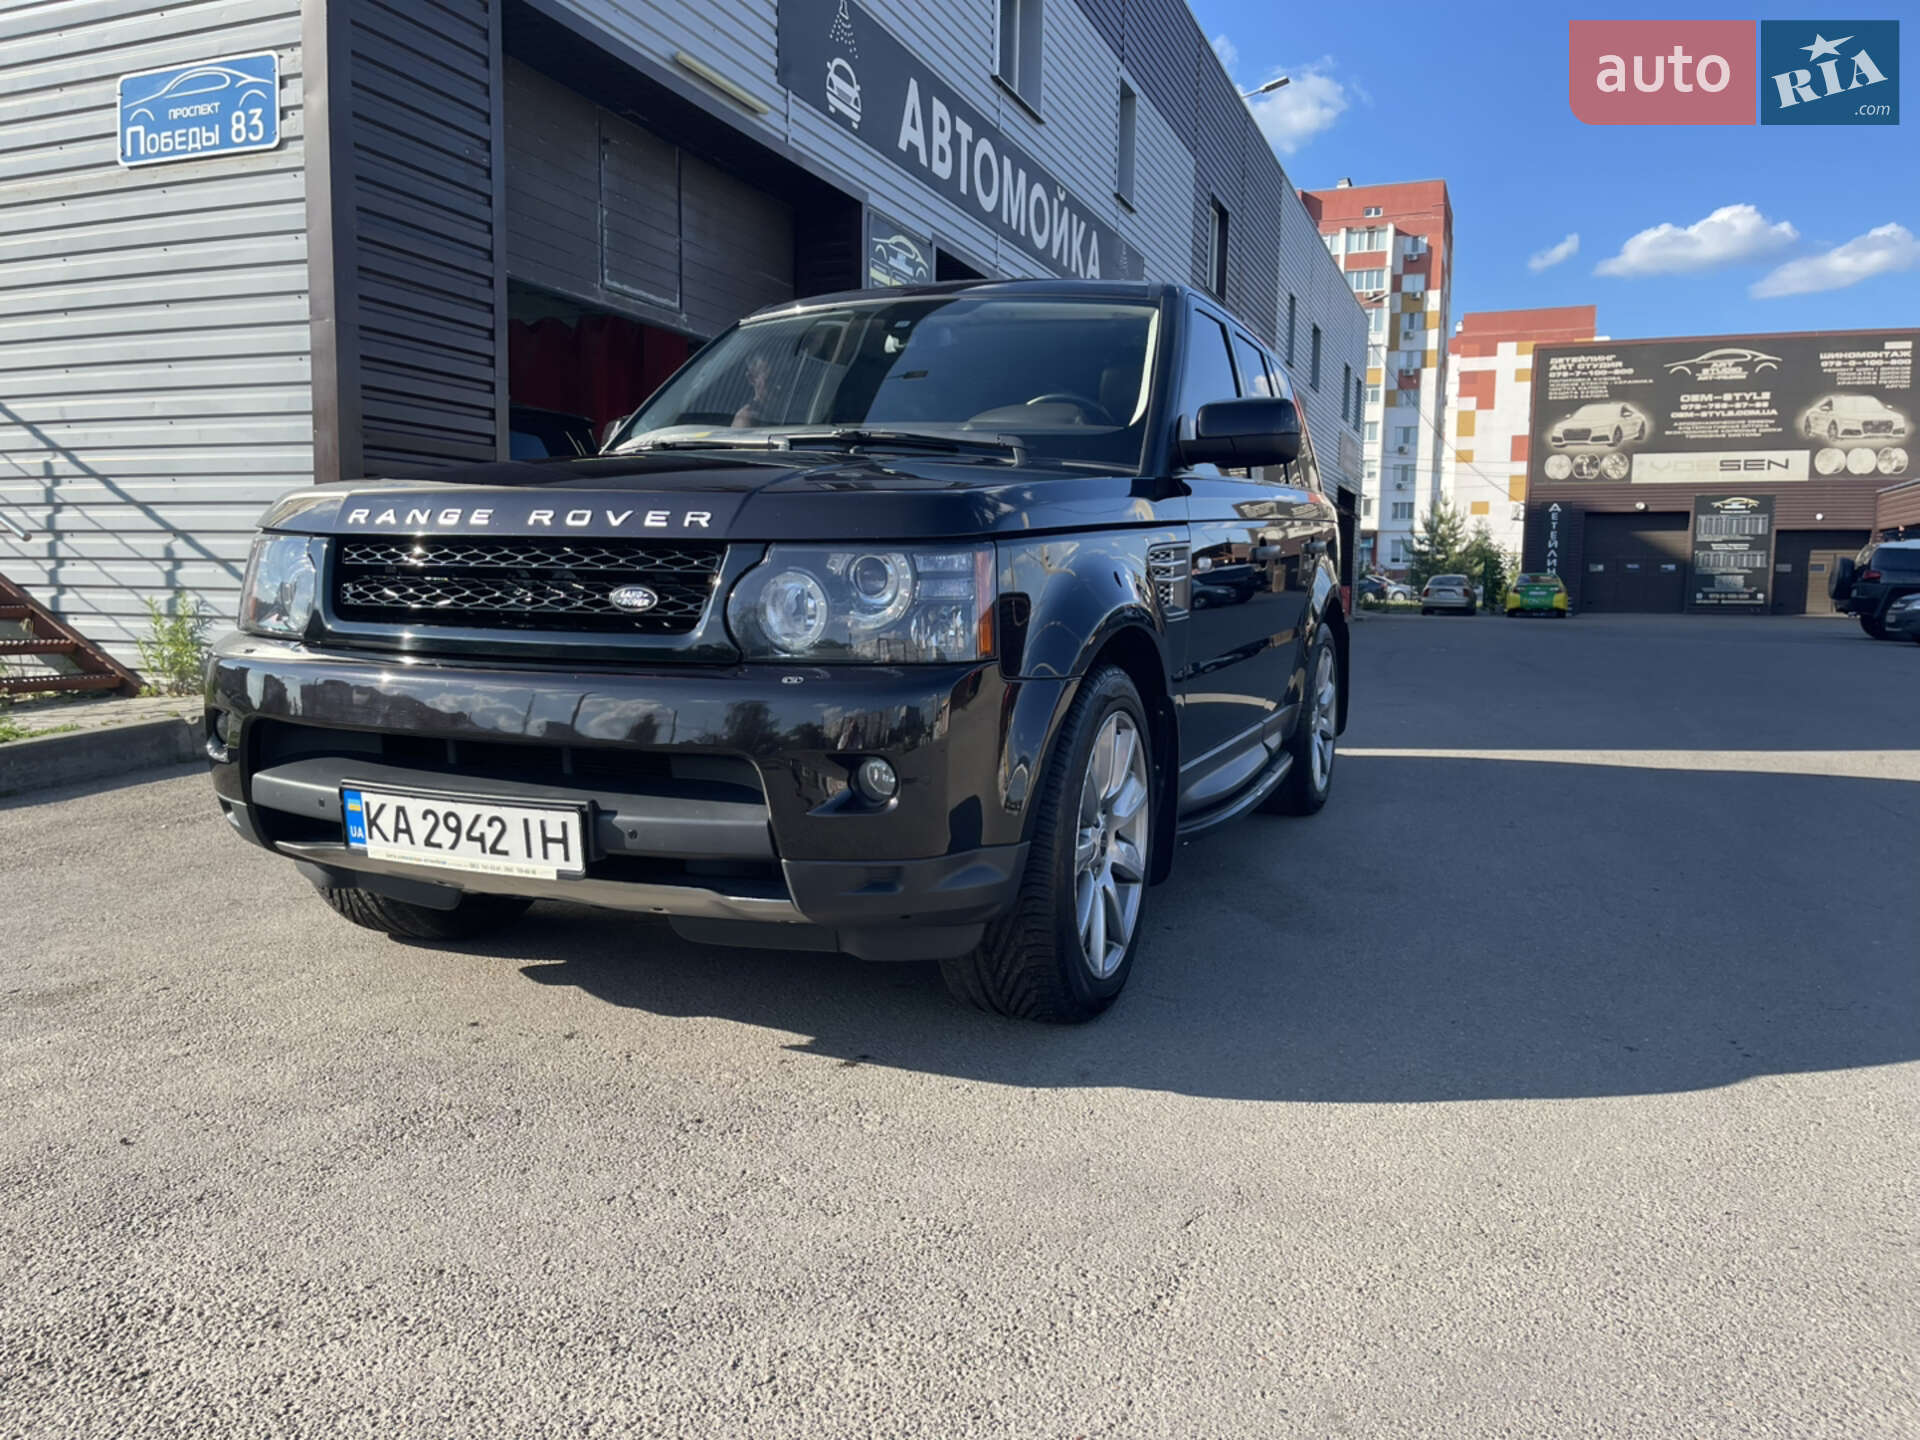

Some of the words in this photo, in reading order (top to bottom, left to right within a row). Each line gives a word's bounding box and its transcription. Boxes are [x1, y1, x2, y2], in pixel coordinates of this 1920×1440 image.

[168, 102, 221, 120] ПРОСПЕКТ
[231, 108, 264, 144] 83
[898, 77, 1101, 279] АВТОМОЙКА
[1820, 351, 1912, 360] ШИНОМОНТАЖ
[348, 508, 494, 526] RANGE
[528, 509, 712, 528] ROVER
[350, 826, 364, 839] UA
[365, 801, 415, 845] KA
[422, 809, 510, 856] 2942
[523, 818, 570, 862] IH
